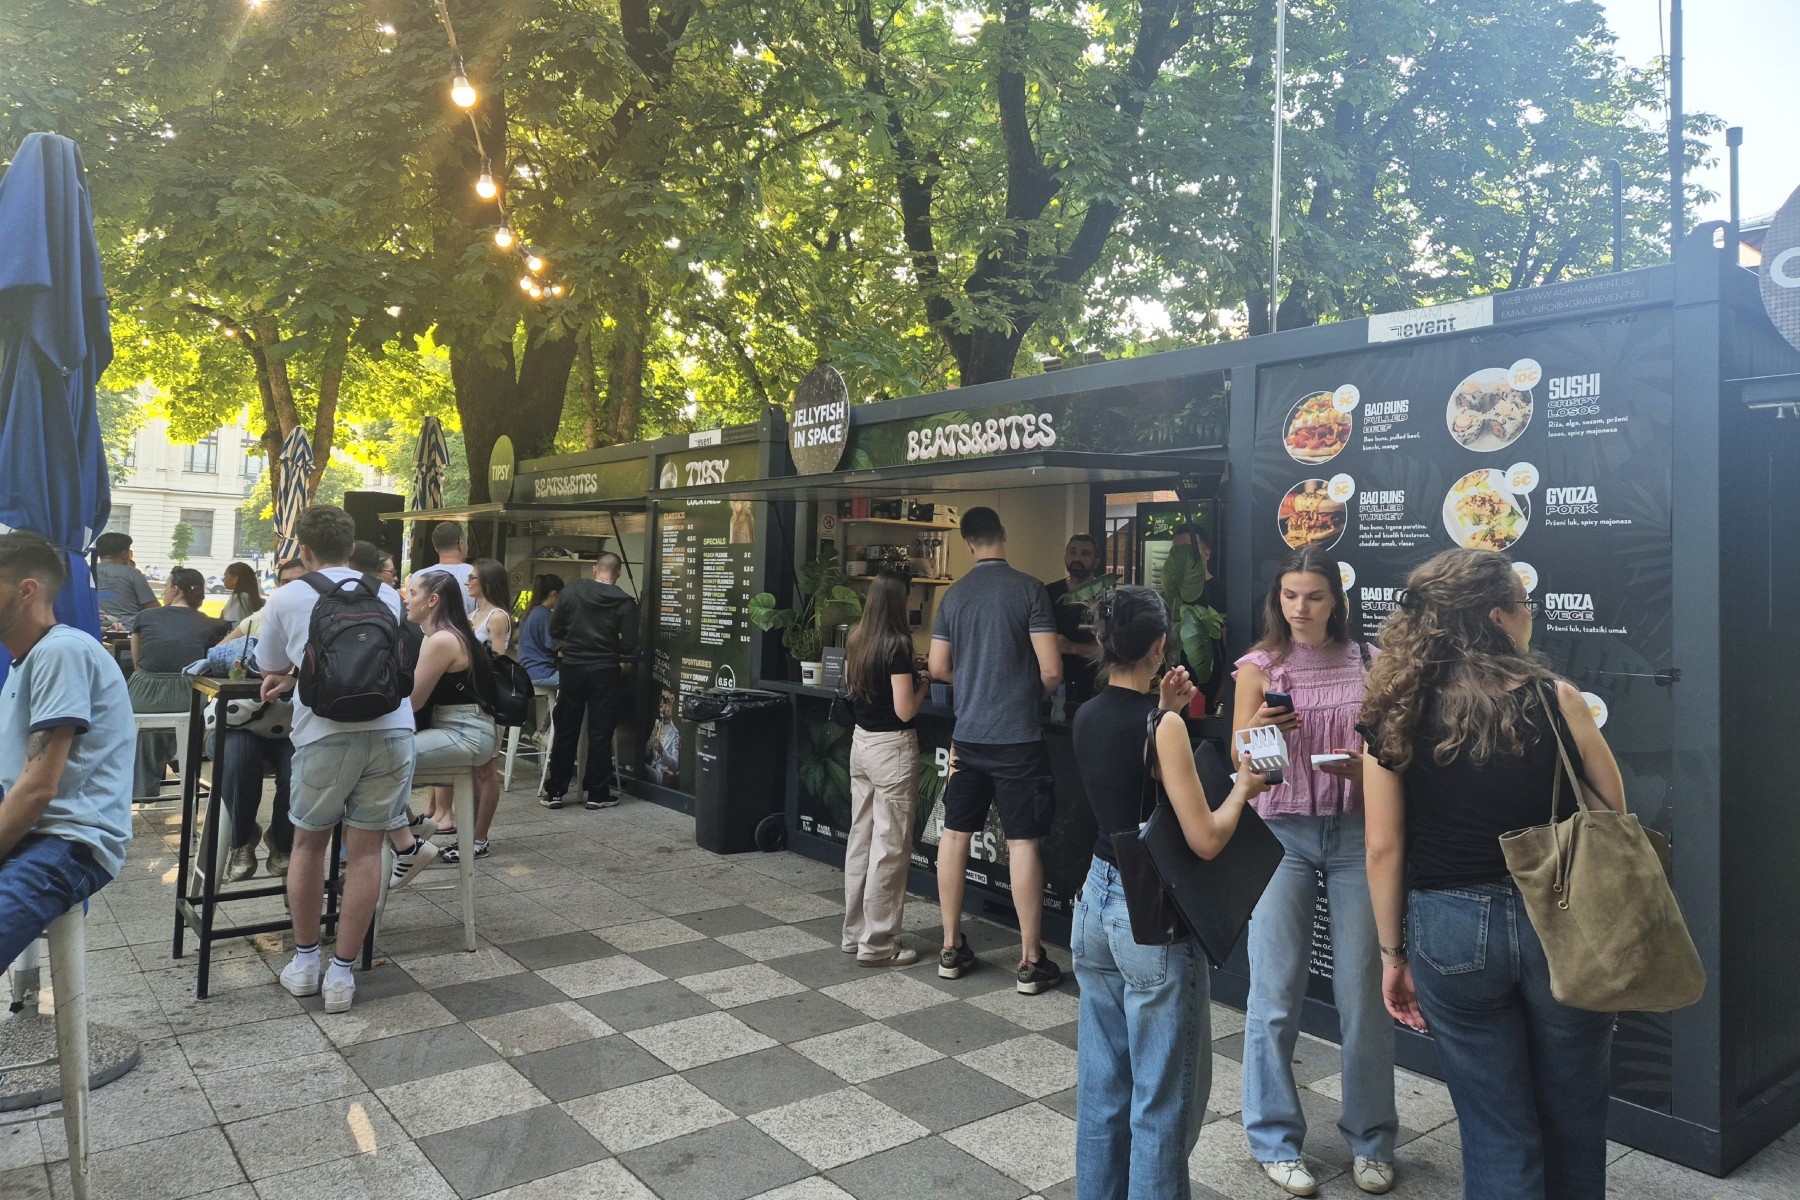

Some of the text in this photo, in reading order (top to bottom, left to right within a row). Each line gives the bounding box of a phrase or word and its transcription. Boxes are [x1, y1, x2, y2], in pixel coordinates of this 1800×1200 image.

[1387, 306, 1441, 325] AGRAM
[1549, 373, 1600, 399] SUSHI
[1364, 399, 1409, 417] BAO BUNS
[1548, 396, 1600, 408] CRISPY
[793, 401, 844, 427] JELLYFISH
[1548, 405, 1600, 418] LOSOS
[1364, 414, 1408, 425] PULLED
[794, 424, 842, 448] IN SPACE
[907, 413, 1056, 460] BEATS&BITES
[1586, 428, 1617, 436] majoneza
[492, 464, 510, 480] TIPSY
[686, 459, 730, 486] TIPSY
[534, 474, 598, 498] BEATS&BITES
[1360, 490, 1404, 504] BAO BUNS
[1546, 486, 1598, 504] GYOZA
[1359, 504, 1404, 512] PULLED
[1546, 504, 1599, 515] PORK
[664, 512, 686, 520] CLASSICS
[1359, 512, 1404, 520] TURKEY
[1600, 518, 1632, 526] majoneza
[1361, 587, 1382, 600] BAO
[1546, 593, 1594, 610] GYOZA
[1545, 610, 1594, 621] VEGE
[1546, 624, 1568, 632] Prženi
[1570, 624, 1581, 632] luk,
[1608, 626, 1627, 634] umak
[718, 677, 727, 687] 6,5
